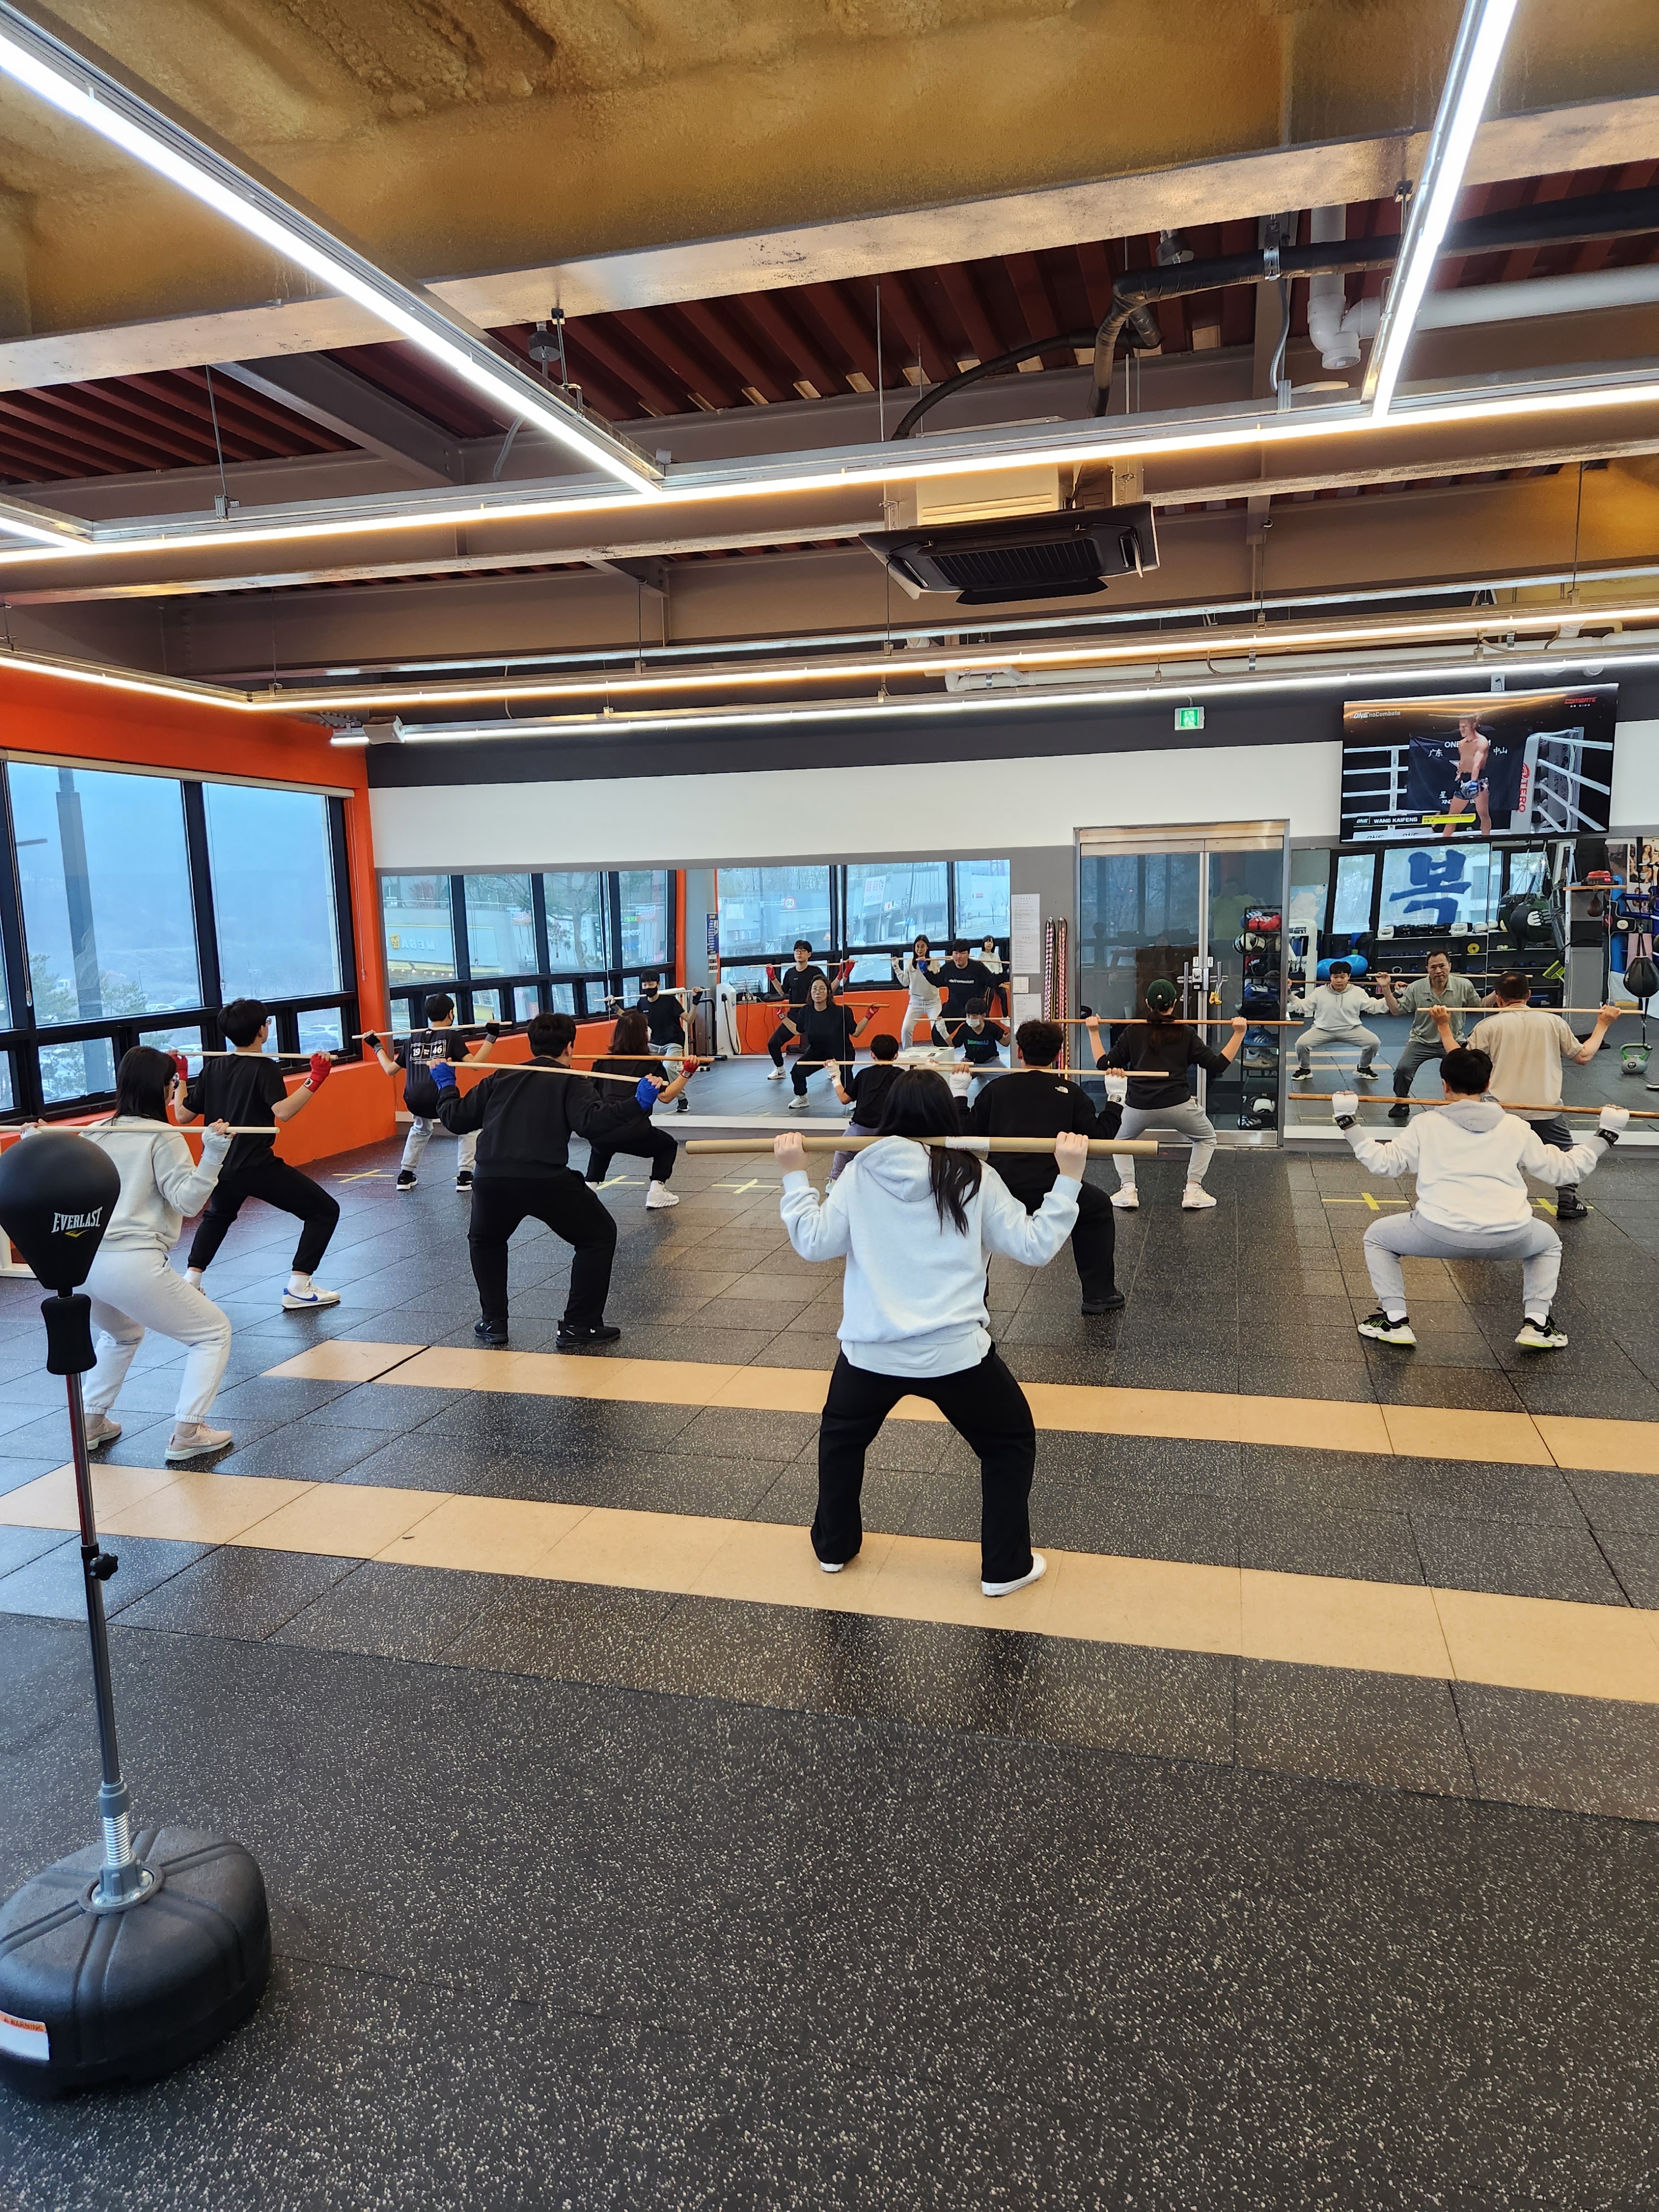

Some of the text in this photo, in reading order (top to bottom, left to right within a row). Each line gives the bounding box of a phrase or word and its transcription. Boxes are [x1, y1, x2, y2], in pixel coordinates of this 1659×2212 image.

[413, 1045, 421, 1057] 19
[432, 1045, 442, 1055] 46
[51, 1206, 103, 1234] EVERLAST
